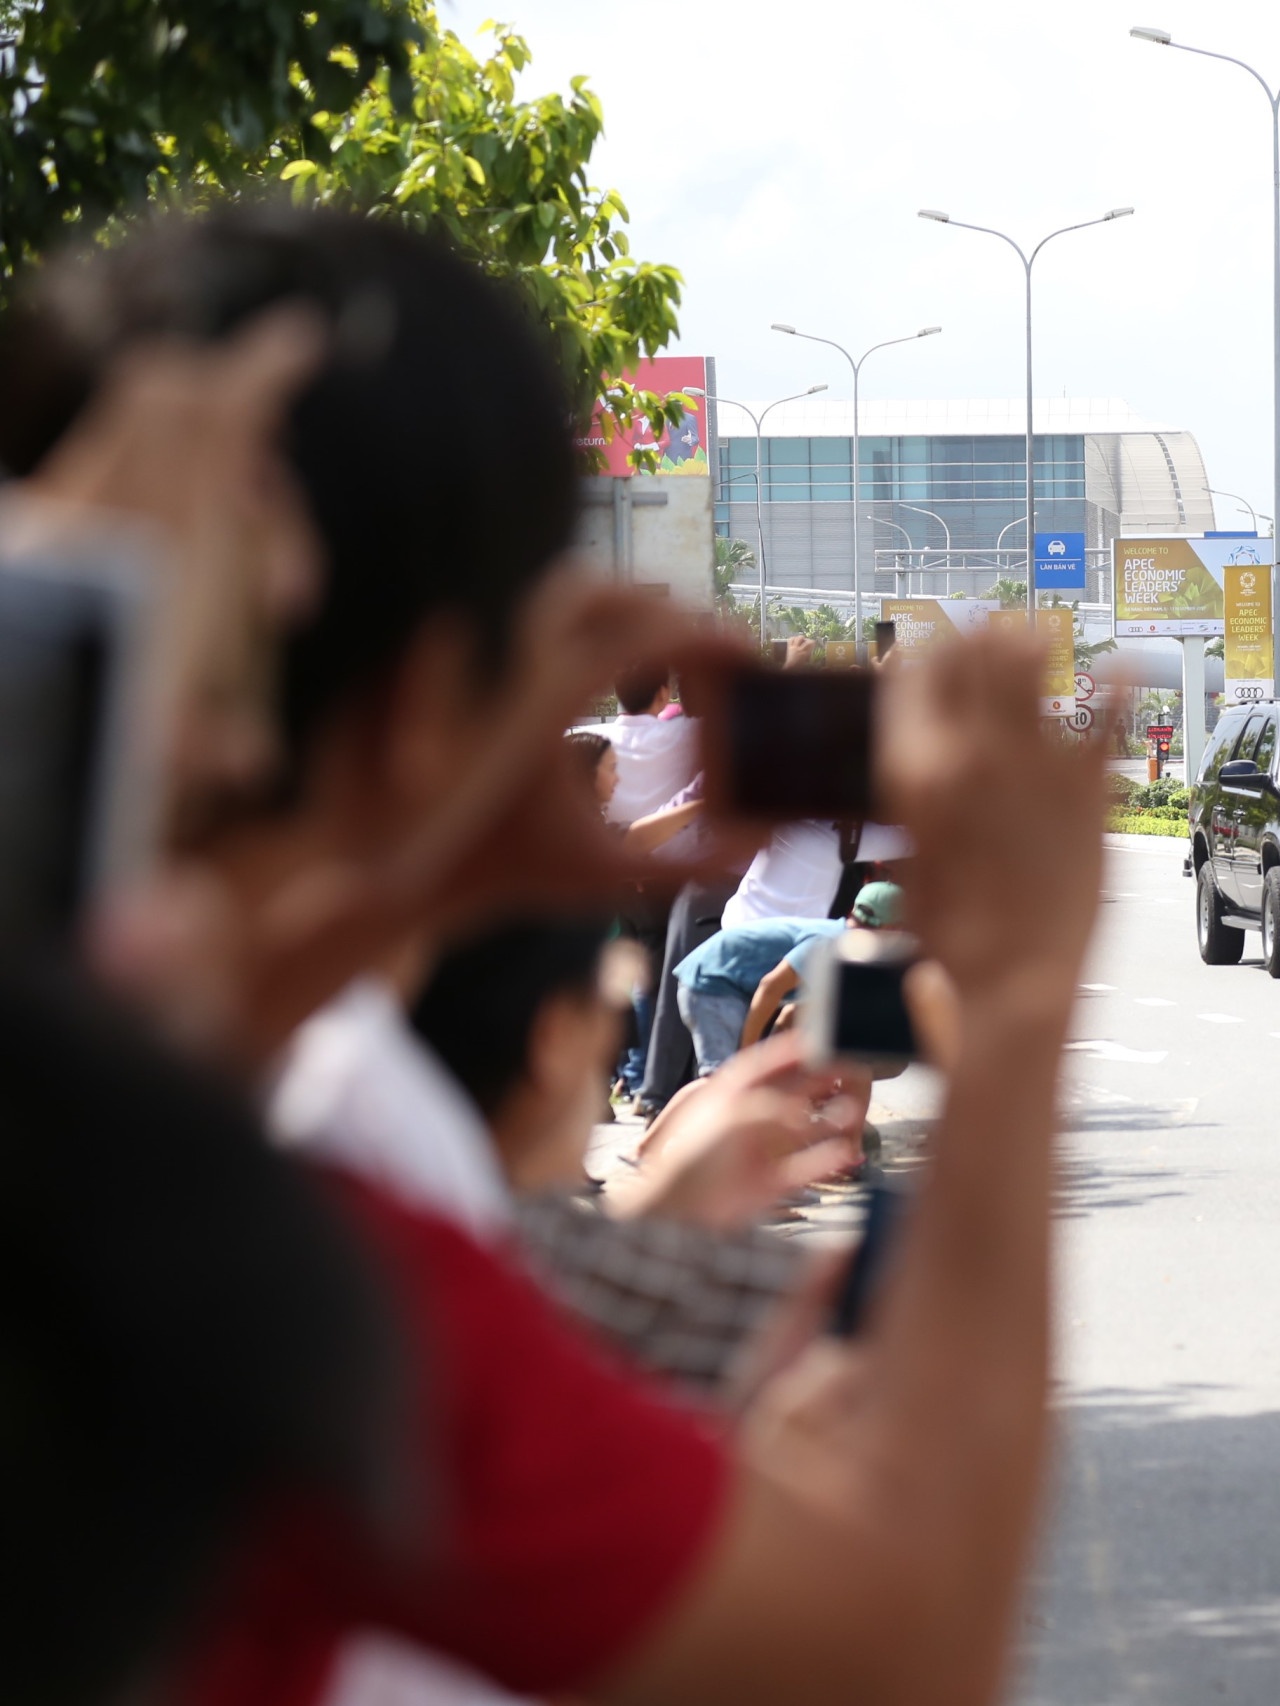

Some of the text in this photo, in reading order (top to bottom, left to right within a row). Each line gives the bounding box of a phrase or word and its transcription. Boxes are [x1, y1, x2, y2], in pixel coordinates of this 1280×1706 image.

[1124, 547, 1168, 555] WELCOME TO
[1124, 559, 1155, 570] APEC
[1124, 570, 1186, 581] ECONOMIC
[1124, 581, 1181, 592] LEADERS'
[1124, 592, 1158, 604] WEEK
[890, 613, 913, 622] APEC
[1230, 617, 1267, 625] ECONOMIC
[893, 621, 936, 630] CONOMIC
[1238, 633, 1258, 641] WEEK
[898, 638, 916, 647] EEK
[1075, 712, 1088, 725] 10
